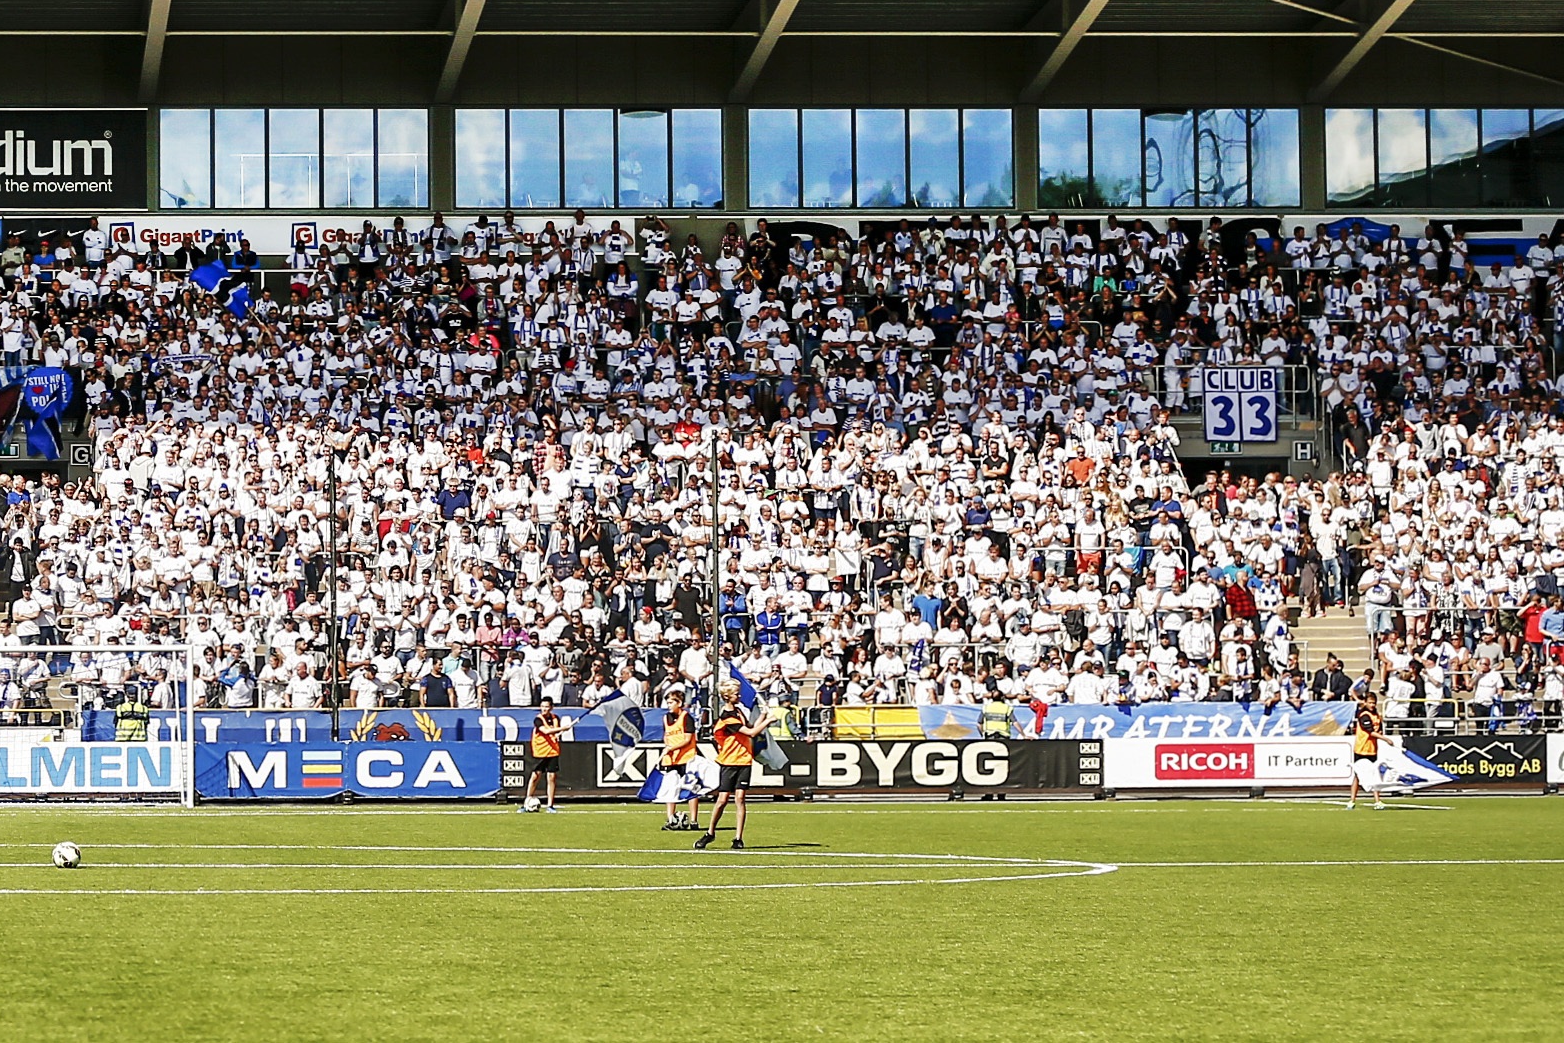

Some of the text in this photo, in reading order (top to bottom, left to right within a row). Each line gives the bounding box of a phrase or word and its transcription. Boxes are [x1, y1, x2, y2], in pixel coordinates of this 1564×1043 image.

[5, 178, 30, 193] the
[33, 178, 113, 193] movement
[140, 228, 244, 247] GigantPnt
[28, 376, 49, 386] STILL
[1206, 369, 1274, 390] CLUB
[1210, 395, 1273, 437] 33
[73, 446, 90, 463] G
[1297, 442, 1311, 459] H
[227, 750, 467, 788] MECA
[1160, 752, 1248, 771] RICOH
[1267, 754, 1339, 767] IT Partner
[1479, 759, 1516, 777] Bygg
[1519, 758, 1542, 774] AB
